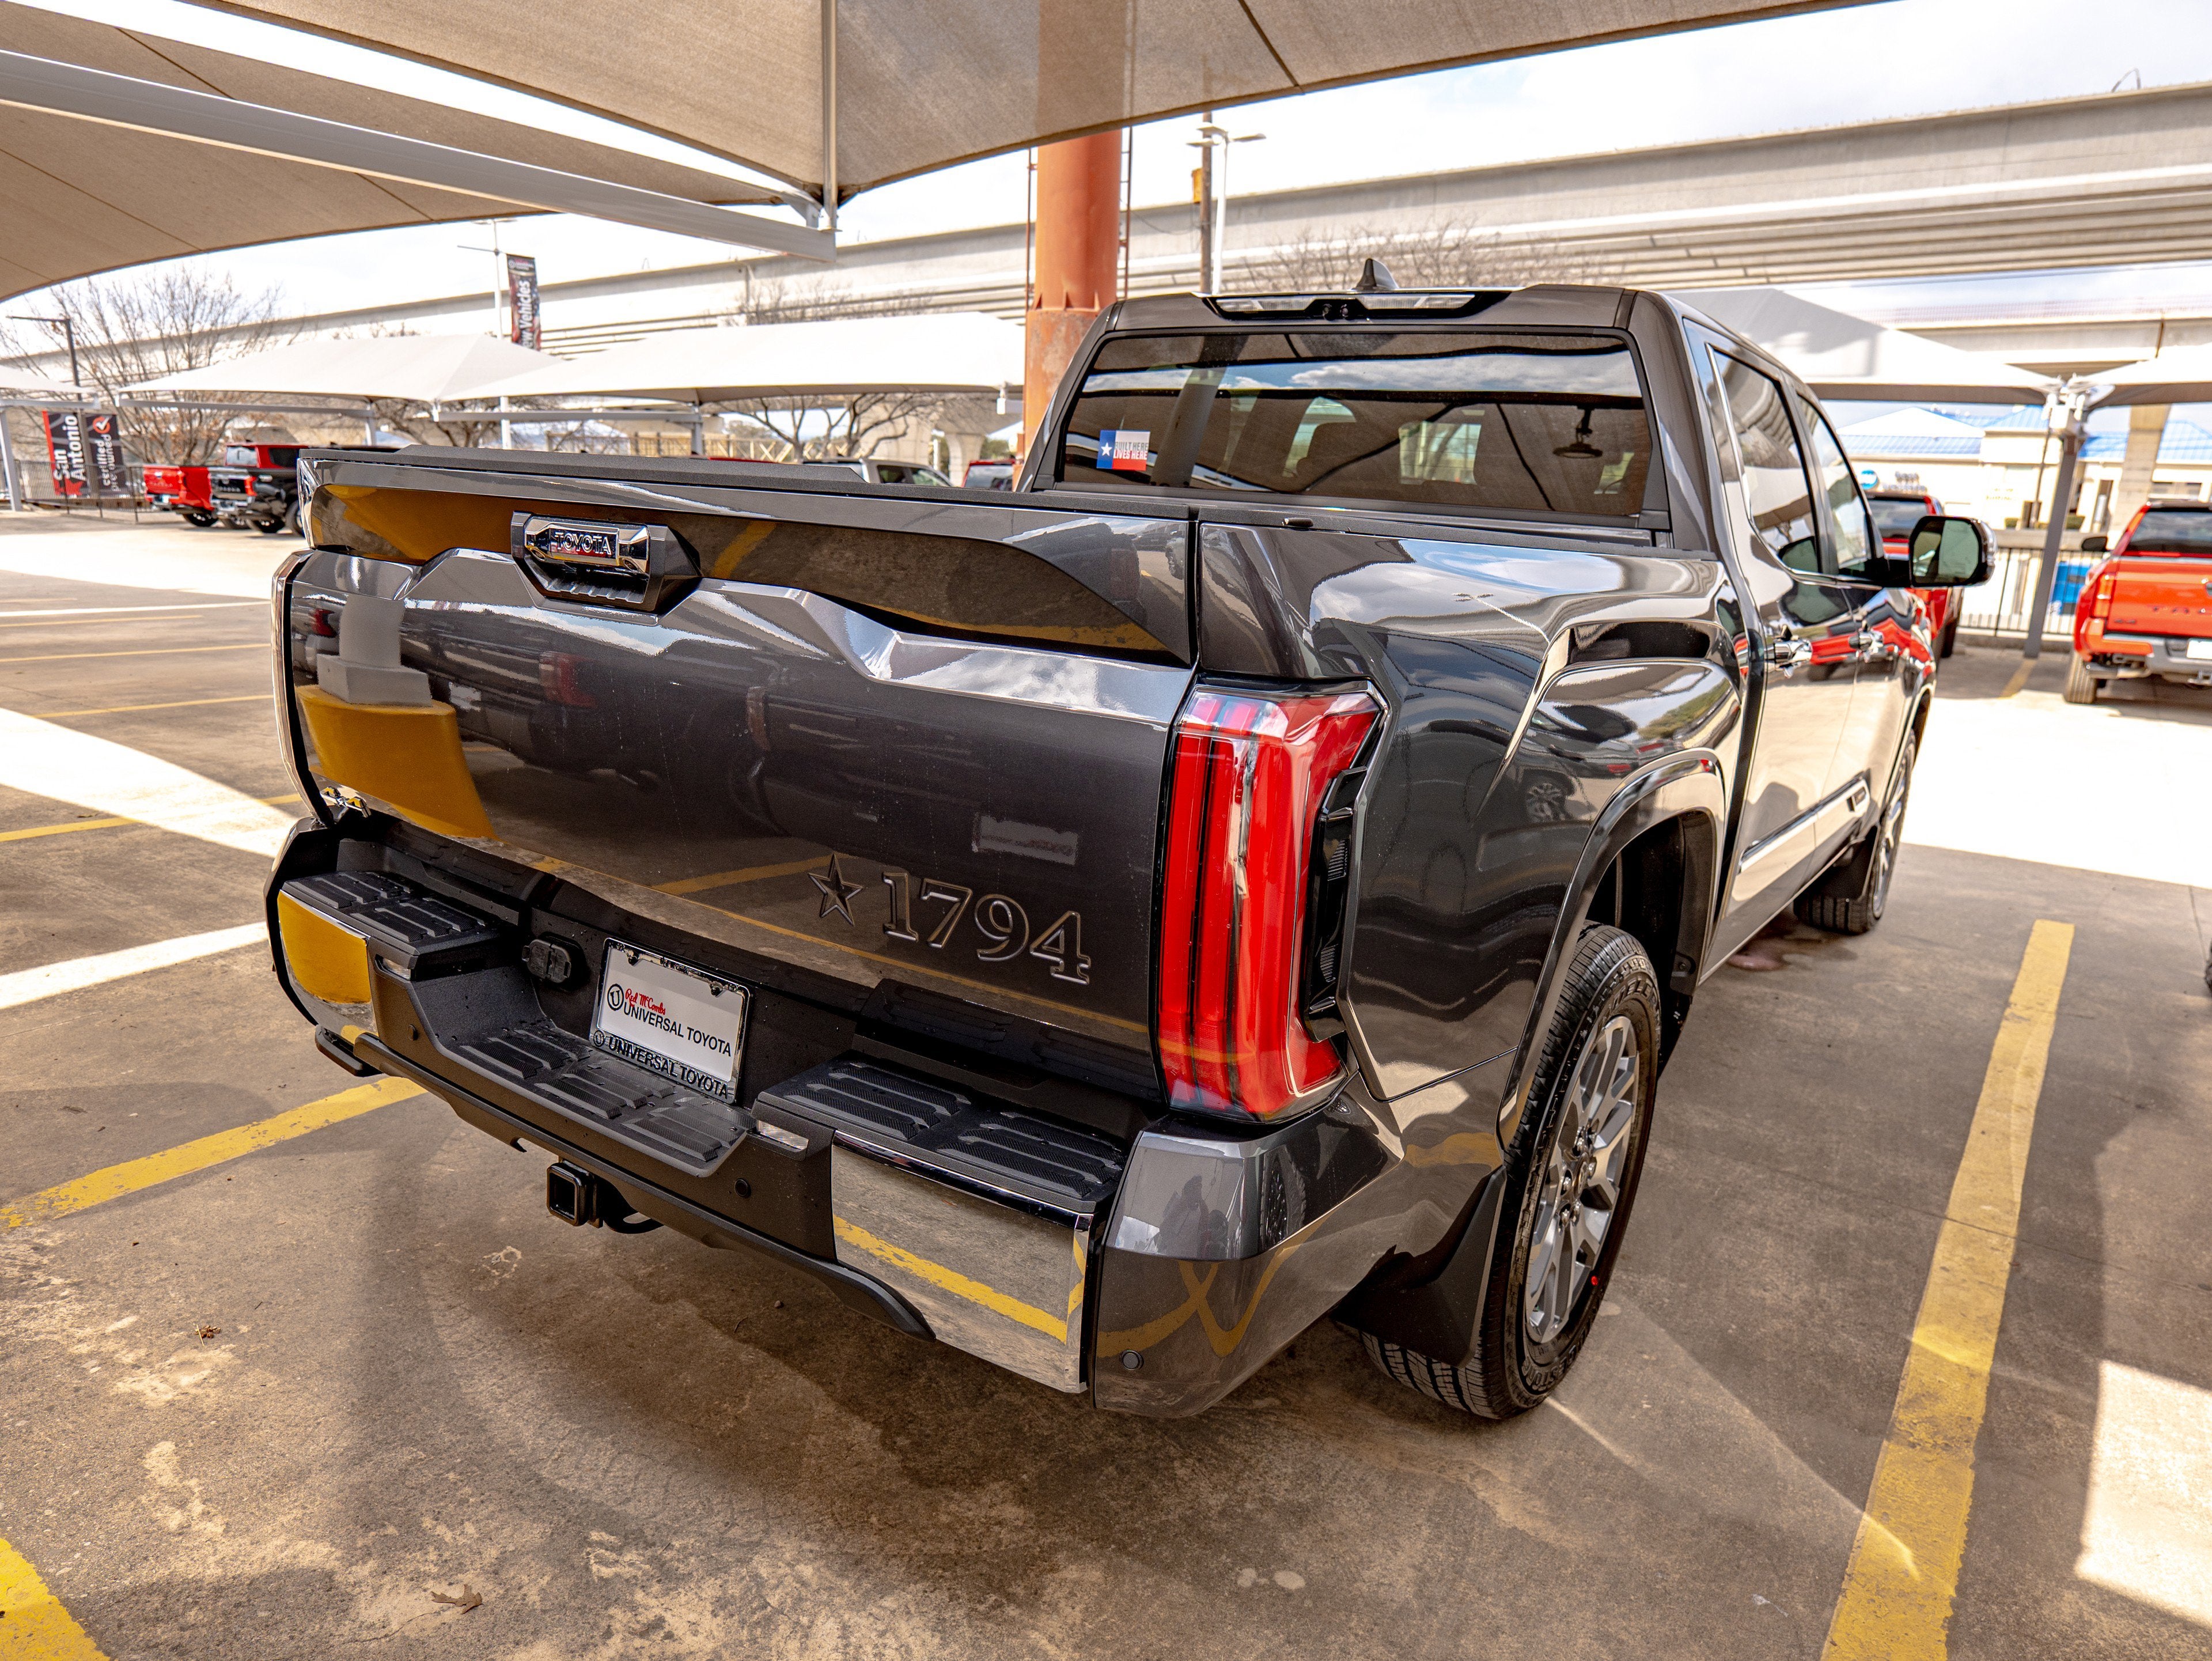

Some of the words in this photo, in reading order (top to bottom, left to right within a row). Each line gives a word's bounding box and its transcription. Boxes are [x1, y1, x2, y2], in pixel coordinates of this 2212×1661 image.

[517, 280, 532, 328] Vehicles
[521, 331, 533, 348] ew
[62, 415, 86, 480] Antonio
[1113, 450, 1130, 460] LIVES
[1131, 451, 1147, 460] HERE
[1115, 442, 1132, 451] BUILT
[1133, 442, 1149, 451] HERE
[53, 449, 70, 480] San
[554, 531, 612, 555] TOYOTA
[881, 871, 1092, 985] 1794
[625, 988, 638, 1007] Red
[639, 992, 666, 1015] McCombs
[624, 1001, 684, 1038] UNIVERSAL
[687, 1027, 731, 1057] TOYOTA
[608, 1035, 678, 1077] UNIVERSAL
[680, 1065, 728, 1099] TOYOTA
